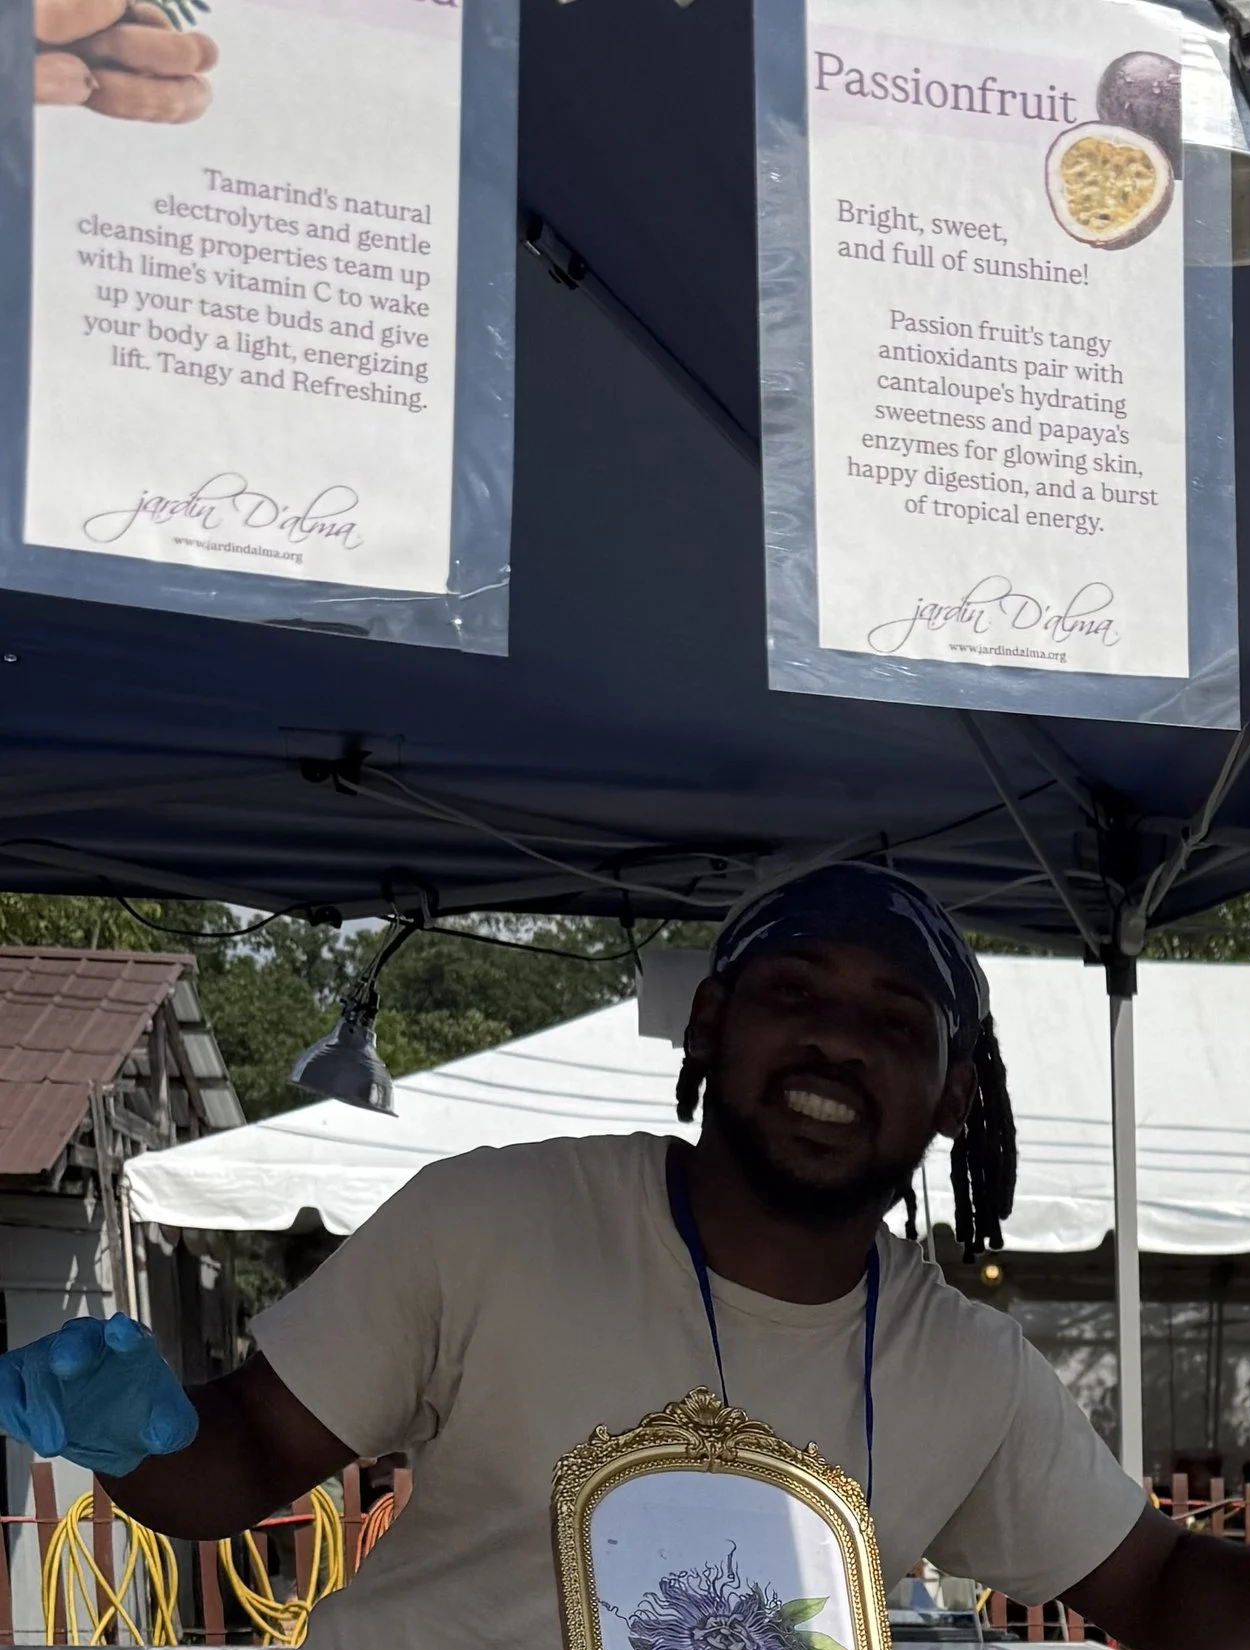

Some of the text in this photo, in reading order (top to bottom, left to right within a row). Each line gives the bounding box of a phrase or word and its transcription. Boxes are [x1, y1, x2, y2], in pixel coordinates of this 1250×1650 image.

[814, 50, 1078, 124] Passionfruit
[203, 167, 432, 226] Tamarind's natural
[836, 198, 1009, 247] Bright, sweet,
[153, 194, 432, 256] electrolytes and gentle
[77, 214, 431, 292] cleansing properties team up
[837, 238, 1089, 287] and full of sunshine!
[77, 248, 431, 318] with lime's vitamin C to wake
[97, 285, 430, 349] up your taste buds and give
[889, 308, 1113, 359] Passion fruit's tangy
[83, 314, 430, 385] your body a light, energizing
[877, 342, 1125, 385] antioxidants pair with
[111, 344, 428, 414] lift. Tangy and Refreshing.
[876, 374, 1128, 421] cantaloupe's hydrating
[874, 403, 1131, 448] sweetness and papaya's
[846, 455, 1160, 507] happy digestion, and a burst
[861, 432, 1144, 479] enzymes for glowing skin,
[904, 493, 1105, 537] of tropical energy.
